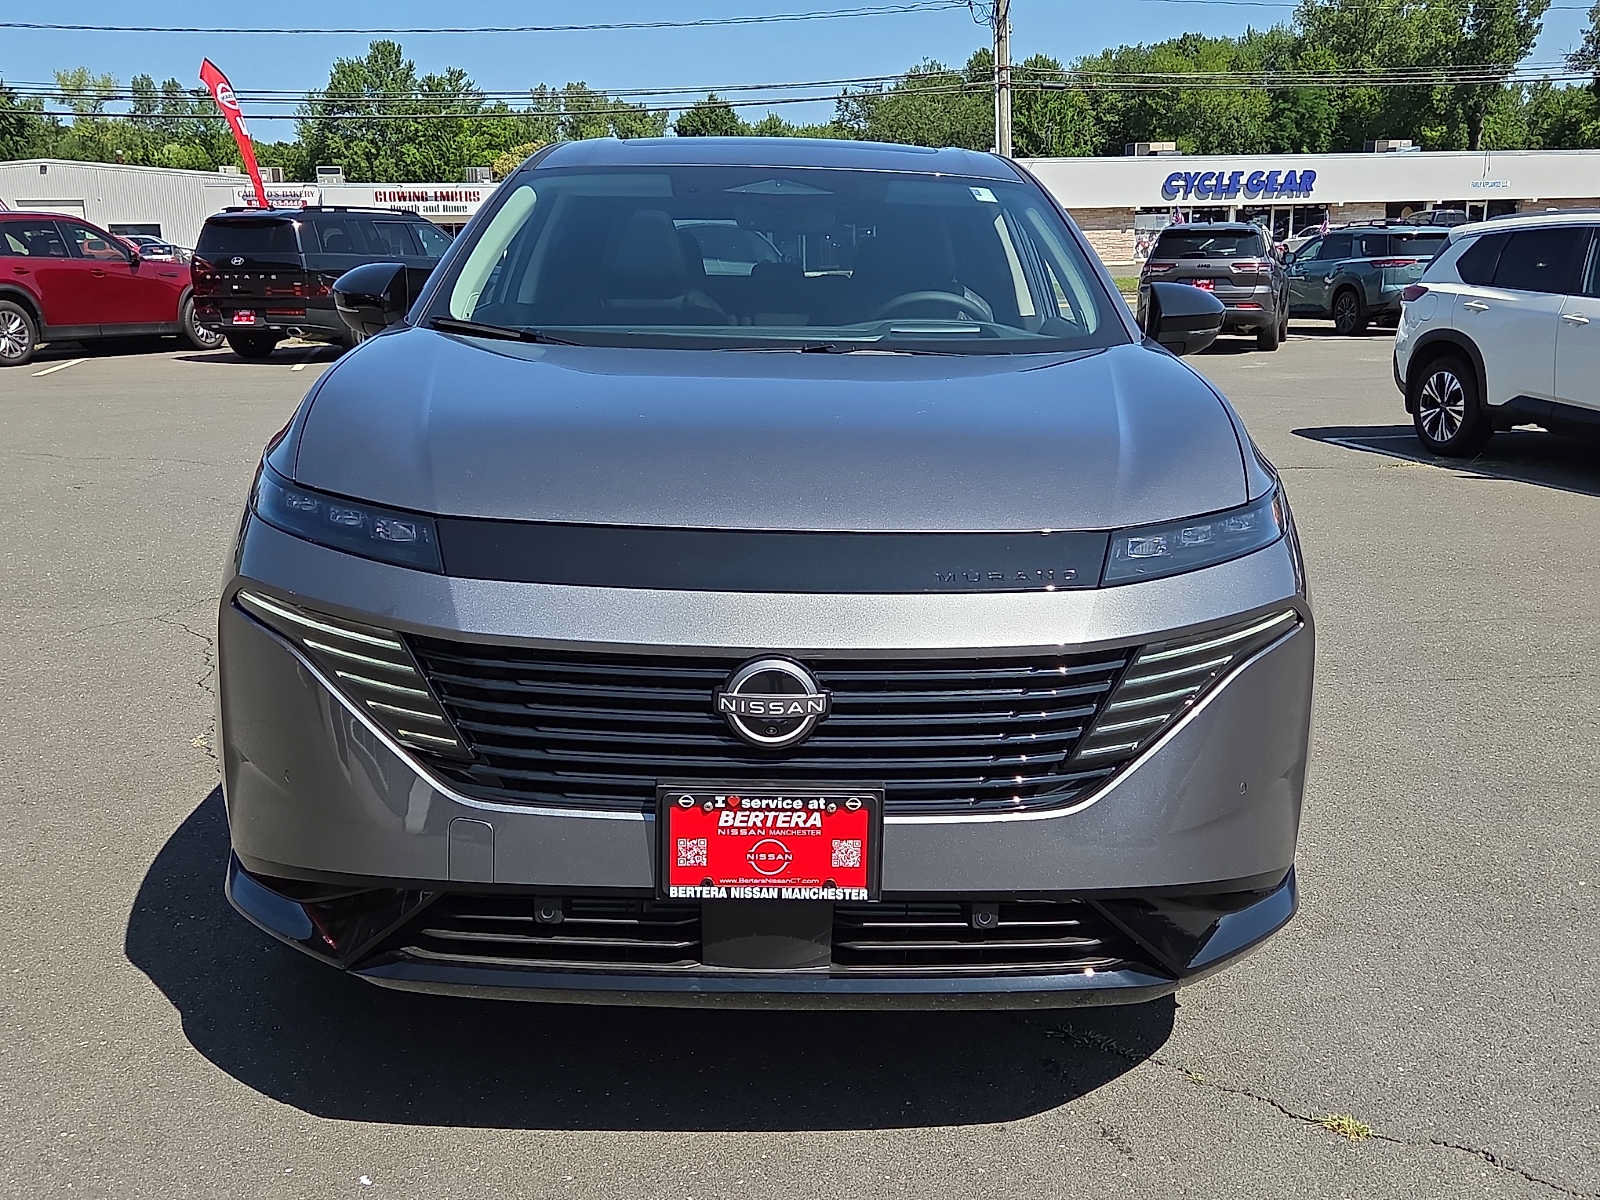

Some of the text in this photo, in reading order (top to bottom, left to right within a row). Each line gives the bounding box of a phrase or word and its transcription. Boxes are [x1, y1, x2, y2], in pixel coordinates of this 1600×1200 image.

[1164, 170, 1317, 197] CYCLE GEAR
[282, 190, 315, 198] BAKERY
[374, 190, 481, 202] GLOWING EMBERS
[422, 204, 440, 213] and
[442, 204, 468, 213] Home
[935, 568, 1079, 584] MURANO
[720, 697, 823, 715] NISSAN
[714, 796, 827, 809] I service at
[717, 811, 823, 828] BERTERA
[746, 853, 793, 861] NISSAN
[669, 886, 868, 900] BERTERA NISSAN MANCHESTER
